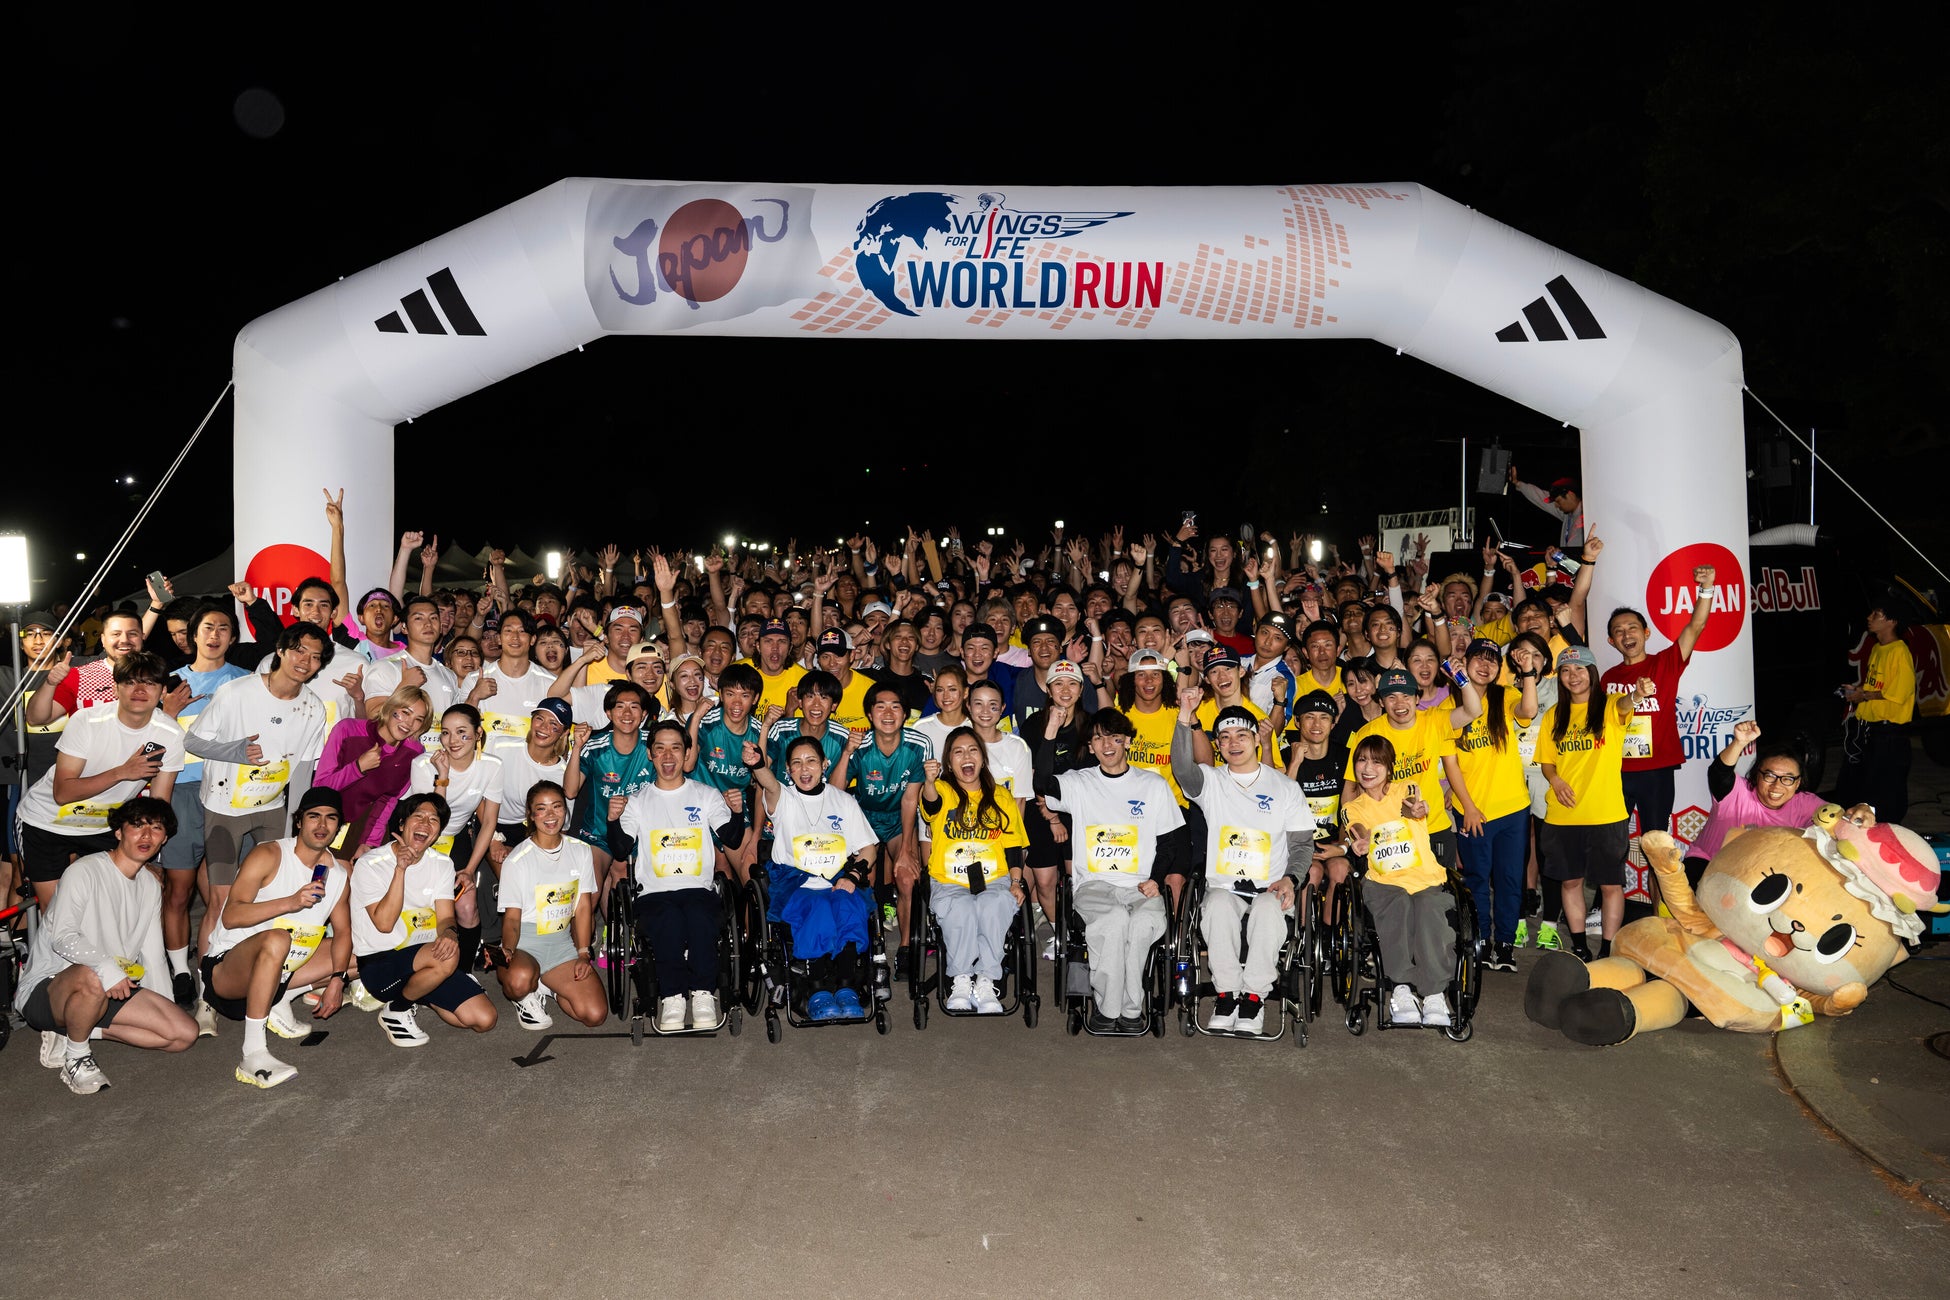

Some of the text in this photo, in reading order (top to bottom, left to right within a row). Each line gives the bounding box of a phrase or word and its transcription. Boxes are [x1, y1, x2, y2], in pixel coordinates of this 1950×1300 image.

[609, 198, 790, 310] Japan
[944, 236, 968, 247] FOR
[1660, 583, 1741, 615] JAAN
[1772, 566, 1821, 612] Bull
[1375, 842, 1411, 860] 200216
